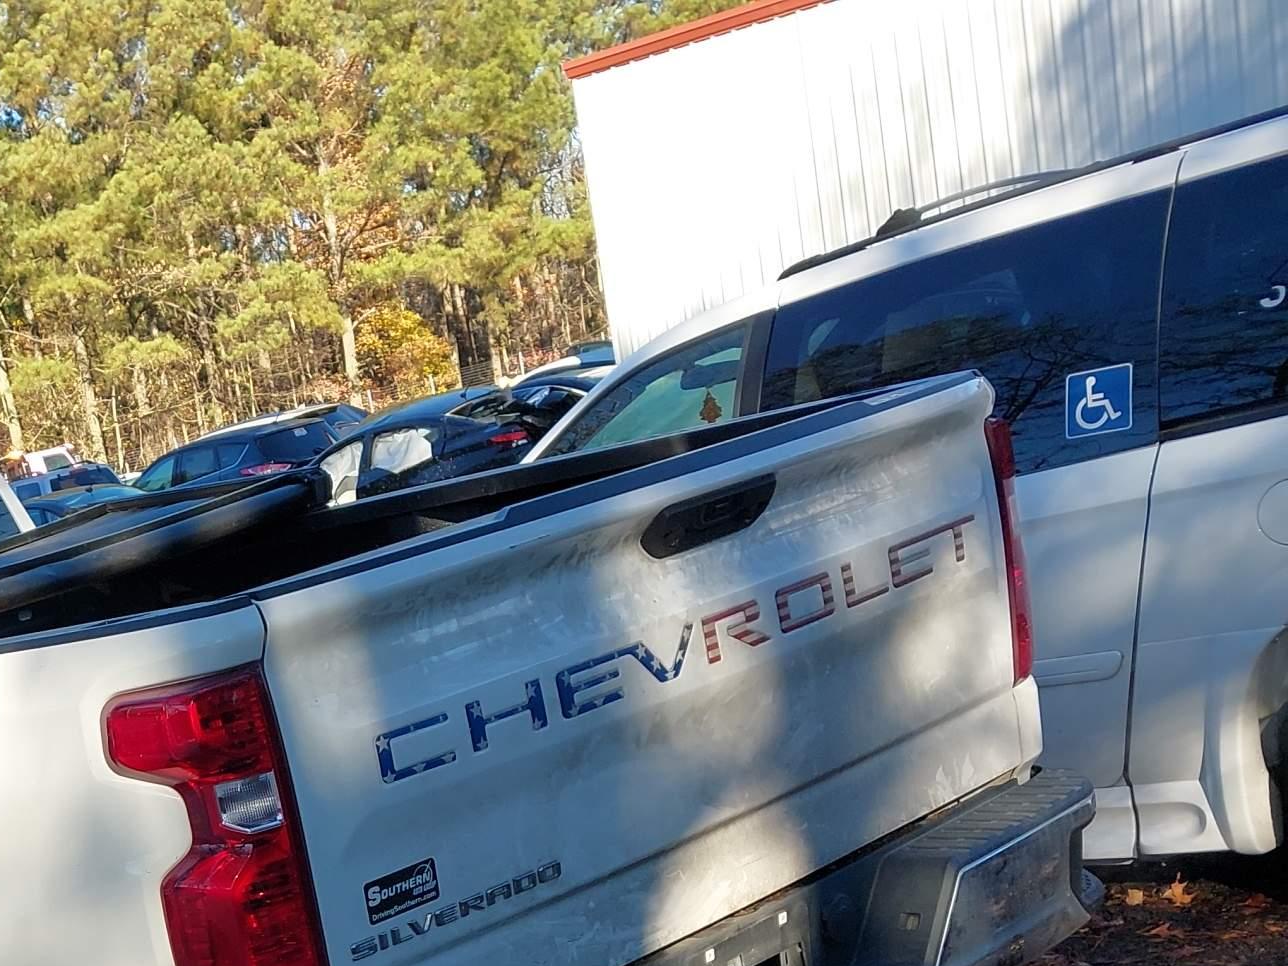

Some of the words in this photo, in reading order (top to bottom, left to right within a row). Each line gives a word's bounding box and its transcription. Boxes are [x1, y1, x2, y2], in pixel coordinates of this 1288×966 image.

[374, 514, 975, 784] CHEVROLET
[350, 859, 562, 962] SILVERADO
[372, 891, 437, 921] DrivingSouthern.com
